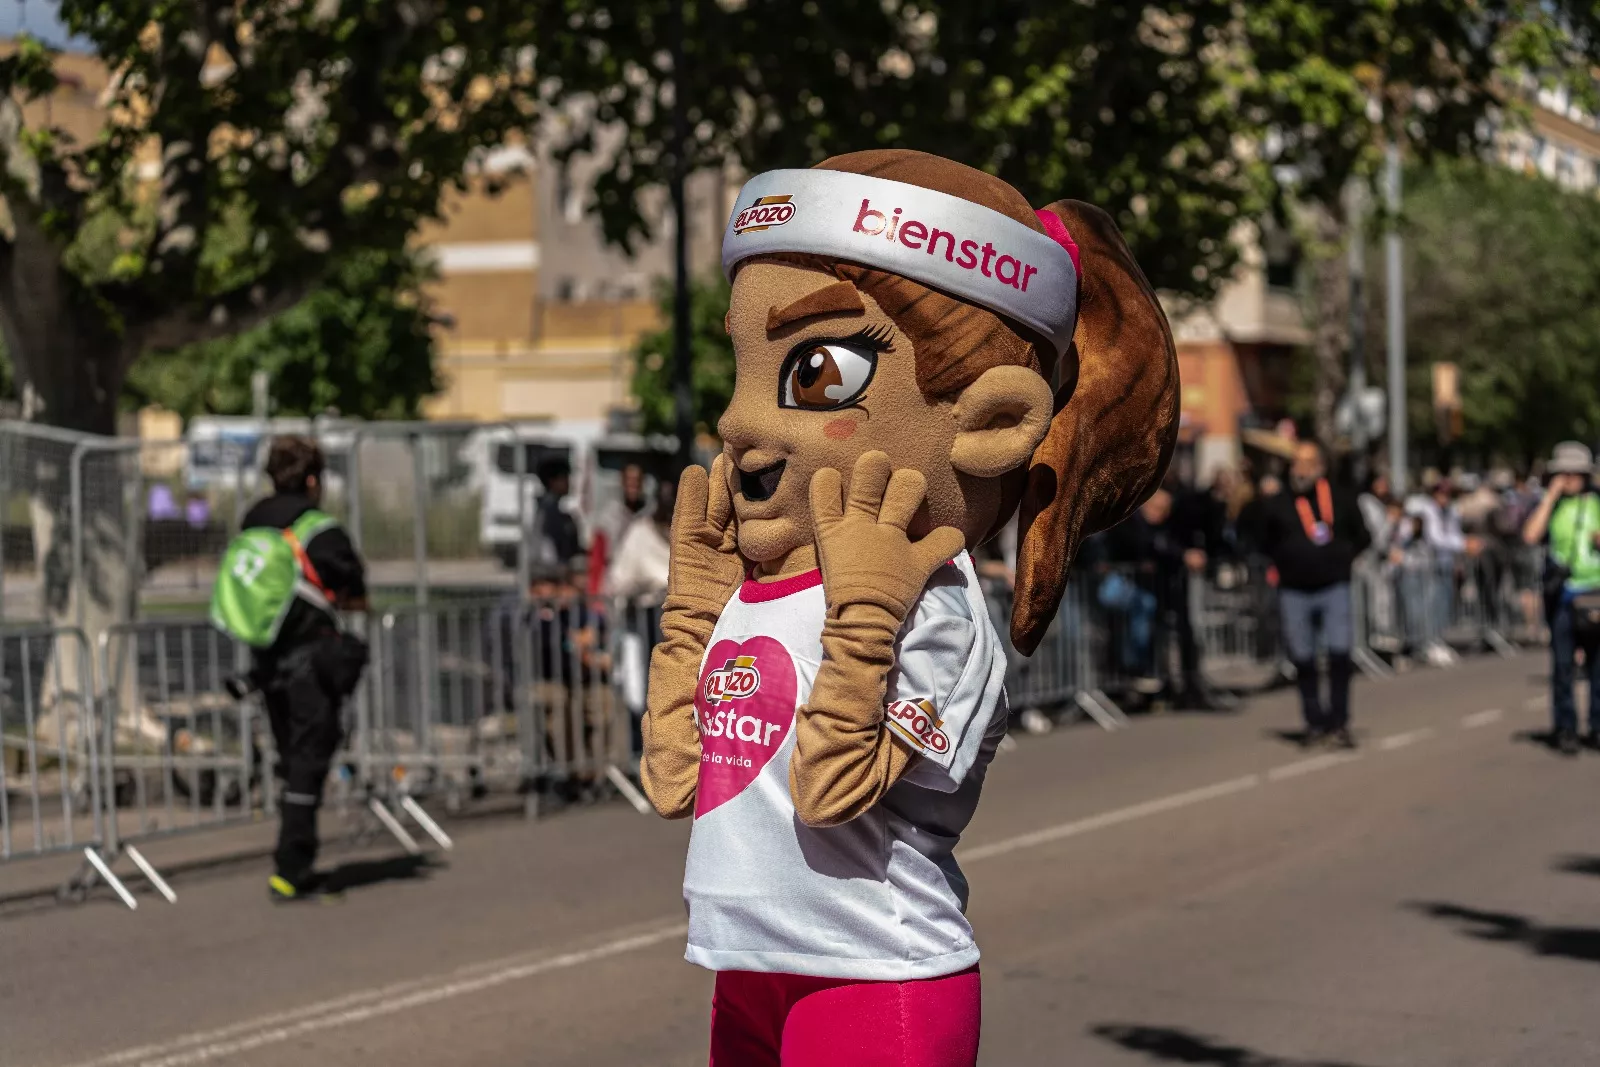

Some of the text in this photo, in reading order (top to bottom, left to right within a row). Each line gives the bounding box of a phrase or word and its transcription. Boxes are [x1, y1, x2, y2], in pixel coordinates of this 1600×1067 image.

[852, 199, 1037, 292] bienstar
[888, 701, 947, 751] LPOZO
[711, 752, 723, 764] la
[726, 756, 752, 768] vida
